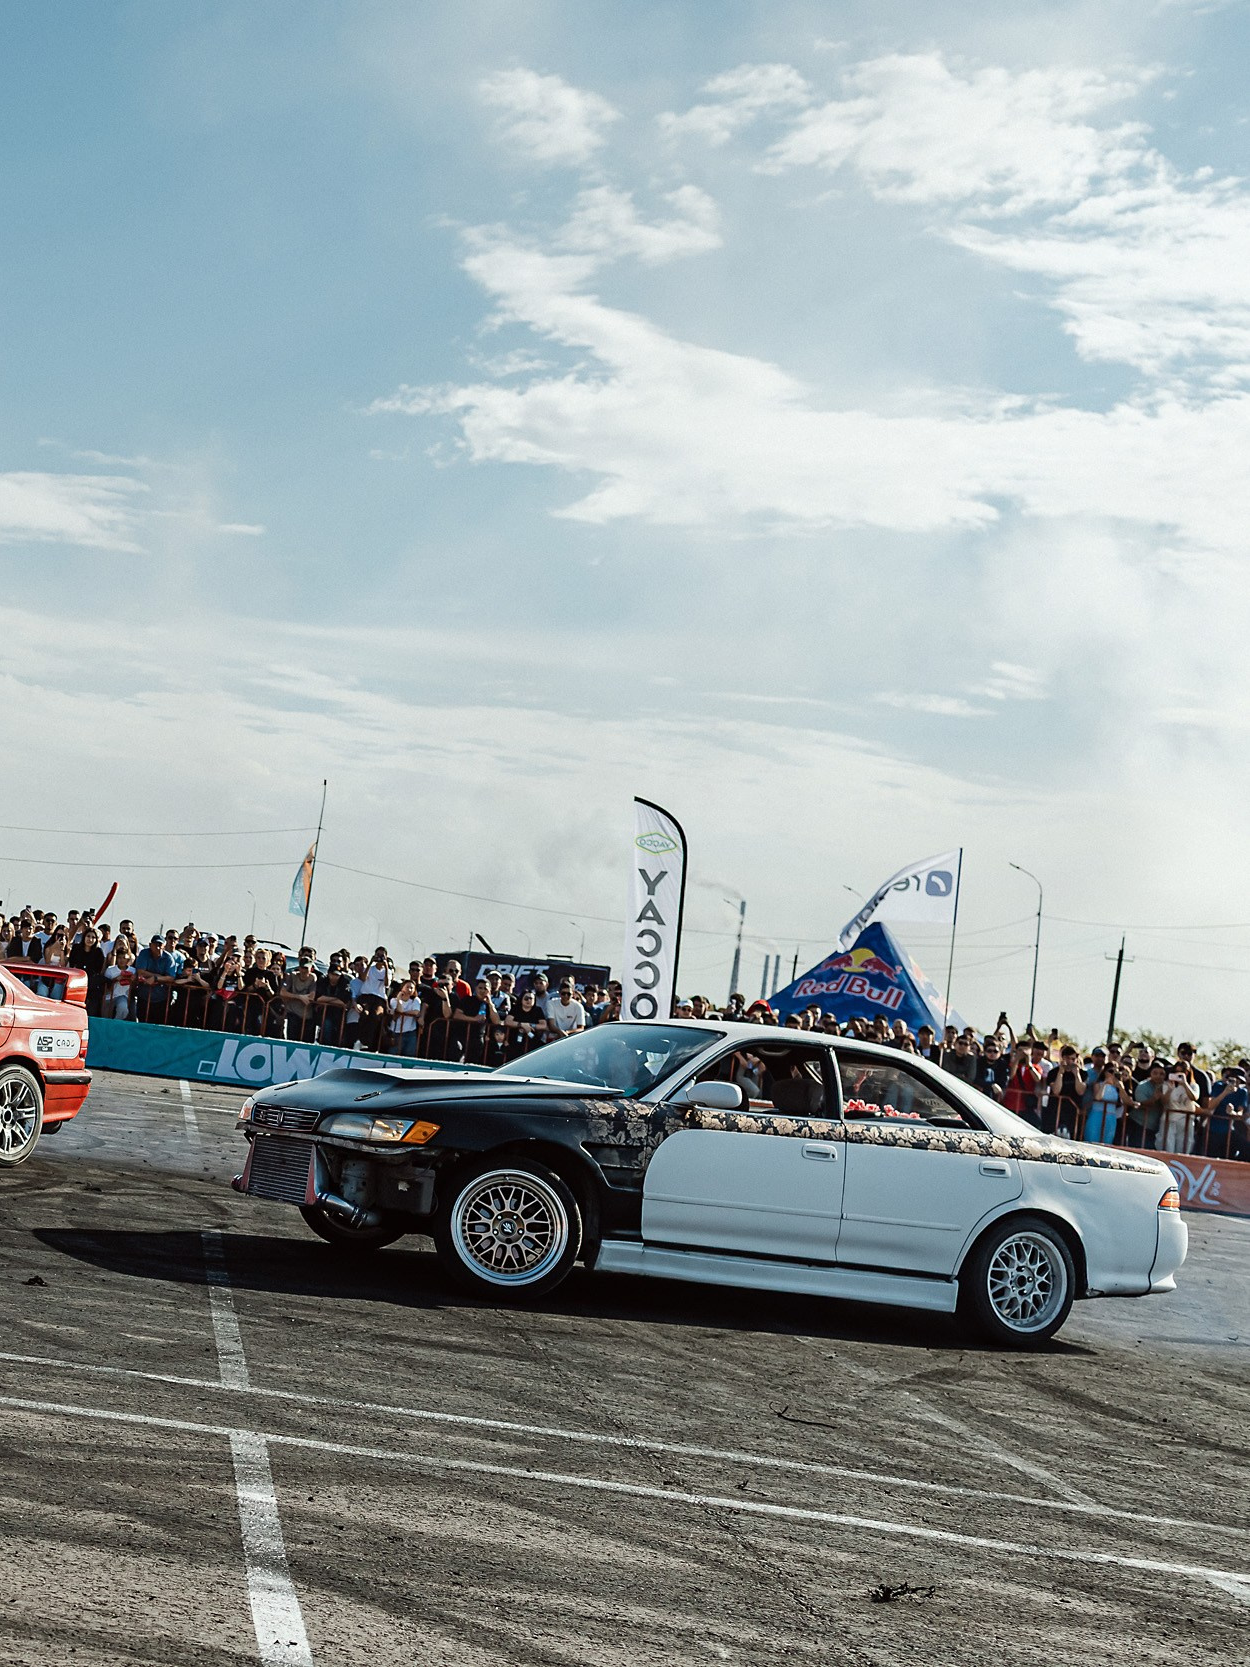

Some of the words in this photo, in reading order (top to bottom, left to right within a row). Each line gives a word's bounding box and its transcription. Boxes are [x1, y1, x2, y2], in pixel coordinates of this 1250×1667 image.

[476, 964, 550, 980] DRIFT
[792, 974, 848, 998] Red
[844, 976, 905, 1010] Bull
